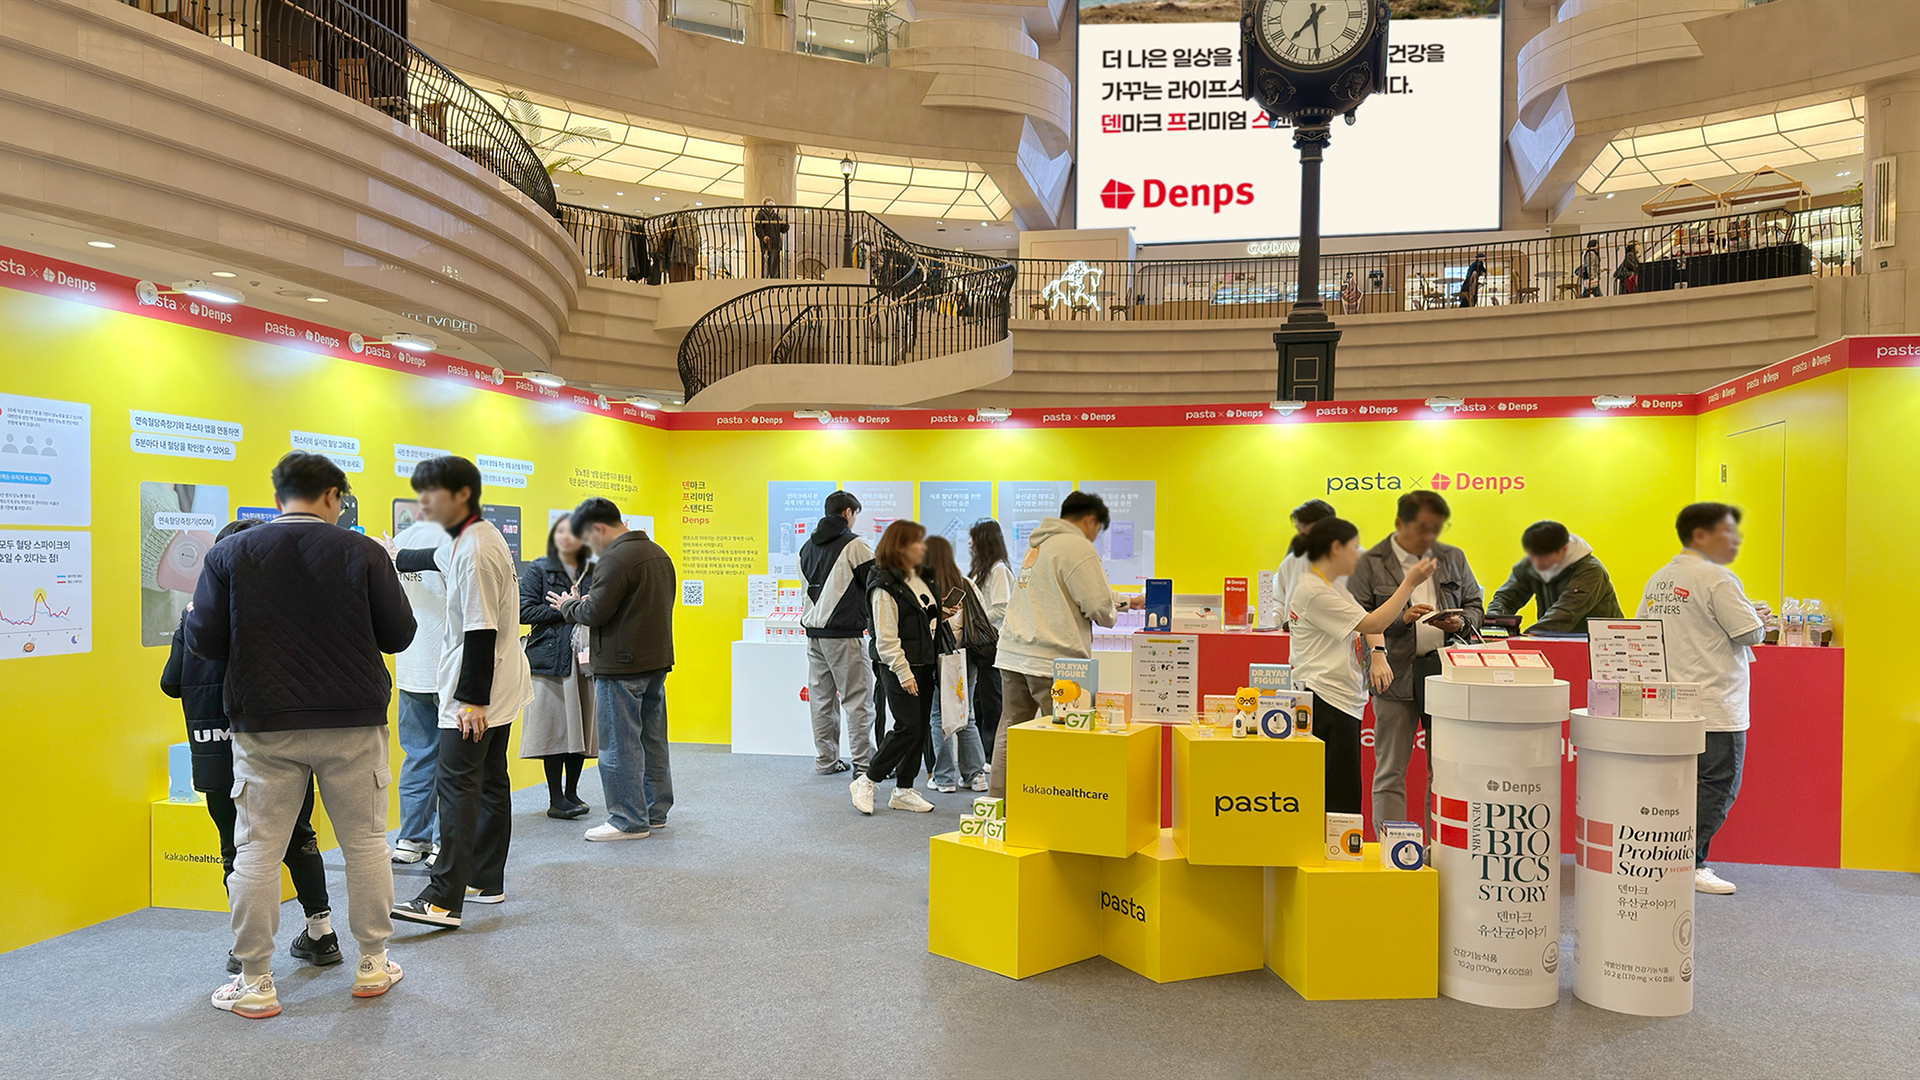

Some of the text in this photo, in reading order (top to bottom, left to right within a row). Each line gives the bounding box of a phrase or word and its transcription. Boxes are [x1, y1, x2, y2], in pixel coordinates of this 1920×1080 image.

[1102, 44, 1445, 69] 더 나은 일상을 건강을
[1102, 80, 1242, 101] 가꾸는 라이프스
[1102, 111, 1247, 134] 덴마크 프리미엄
[1143, 178, 1255, 214] Denps
[0, 258, 97, 292] sta Denps
[201, 304, 232, 324] Denps
[265, 320, 340, 348] pasta Denps
[366, 344, 426, 368] pasta Denps
[1876, 345, 1920, 358] pasta
[447, 364, 469, 377] pasta
[1792, 353, 1831, 376] pasta Denps
[1746, 371, 1780, 390] pasta Denps
[516, 380, 560, 399] pasta Denps
[574, 394, 590, 406] pasta
[1454, 402, 1538, 414] pasta Denps
[1652, 398, 1684, 410] Denps
[624, 406, 656, 422] pasta Denps
[930, 414, 958, 424] pasta
[1042, 412, 1116, 424] pasta Denps
[1186, 408, 1264, 420] pasta Denps
[1316, 405, 1398, 417] pasta Denps
[134, 416, 240, 437] 연속혈당측정기와 파스타 앱을 연동하면
[716, 416, 783, 426] pasta Denps
[830, 415, 890, 424] asta Denps
[135, 438, 232, 456] 5분마다 내 혈당을 확인할 수 있어요.
[682, 480, 706, 490] 덴마크
[1326, 472, 1526, 495] pasta Denps
[682, 492, 714, 502] 프리미엄
[682, 504, 714, 514] 스탠다드
[158, 517, 214, 527] 연속혈당측정기(CGM)
[682, 516, 710, 526] Denps
[0, 540, 71, 550] 모두 혈당 스파이크의
[14, 553, 58, 564] 수 있다는 점!
[1055, 662, 1088, 672] DR.RYAN
[1057, 670, 1086, 678] FIGURE
[1251, 669, 1288, 678] DR.RYAN
[1254, 677, 1286, 685] FIGURE
[1065, 712, 1090, 728] G7
[1022, 784, 1109, 800] kakaohealthcare
[1502, 780, 1542, 794] Denps
[973, 802, 996, 818] G7
[1214, 792, 1300, 816] pasta
[1484, 802, 1551, 830] PRO
[1652, 807, 1680, 818] Denps
[960, 820, 984, 835] G7
[987, 822, 1003, 838] G7
[1472, 802, 1481, 852] DENMARK
[1618, 825, 1694, 843] Denmark
[1486, 829, 1551, 857] BIO
[164, 852, 227, 865] kakaohealthca
[1618, 843, 1695, 861] Probiotics
[1472, 854, 1550, 882] TICS
[1616, 860, 1669, 882] Story
[1478, 884, 1550, 903] STORY
[1617, 884, 1650, 896] 덴마크
[1100, 890, 1146, 923] pasta
[1616, 897, 1677, 910] 유산균이야기
[1496, 910, 1533, 924] 덴마크
[1616, 909, 1638, 922] 우먼
[1477, 924, 1548, 940] 유산균이야기
[1452, 946, 1498, 963] 건강기능식품
